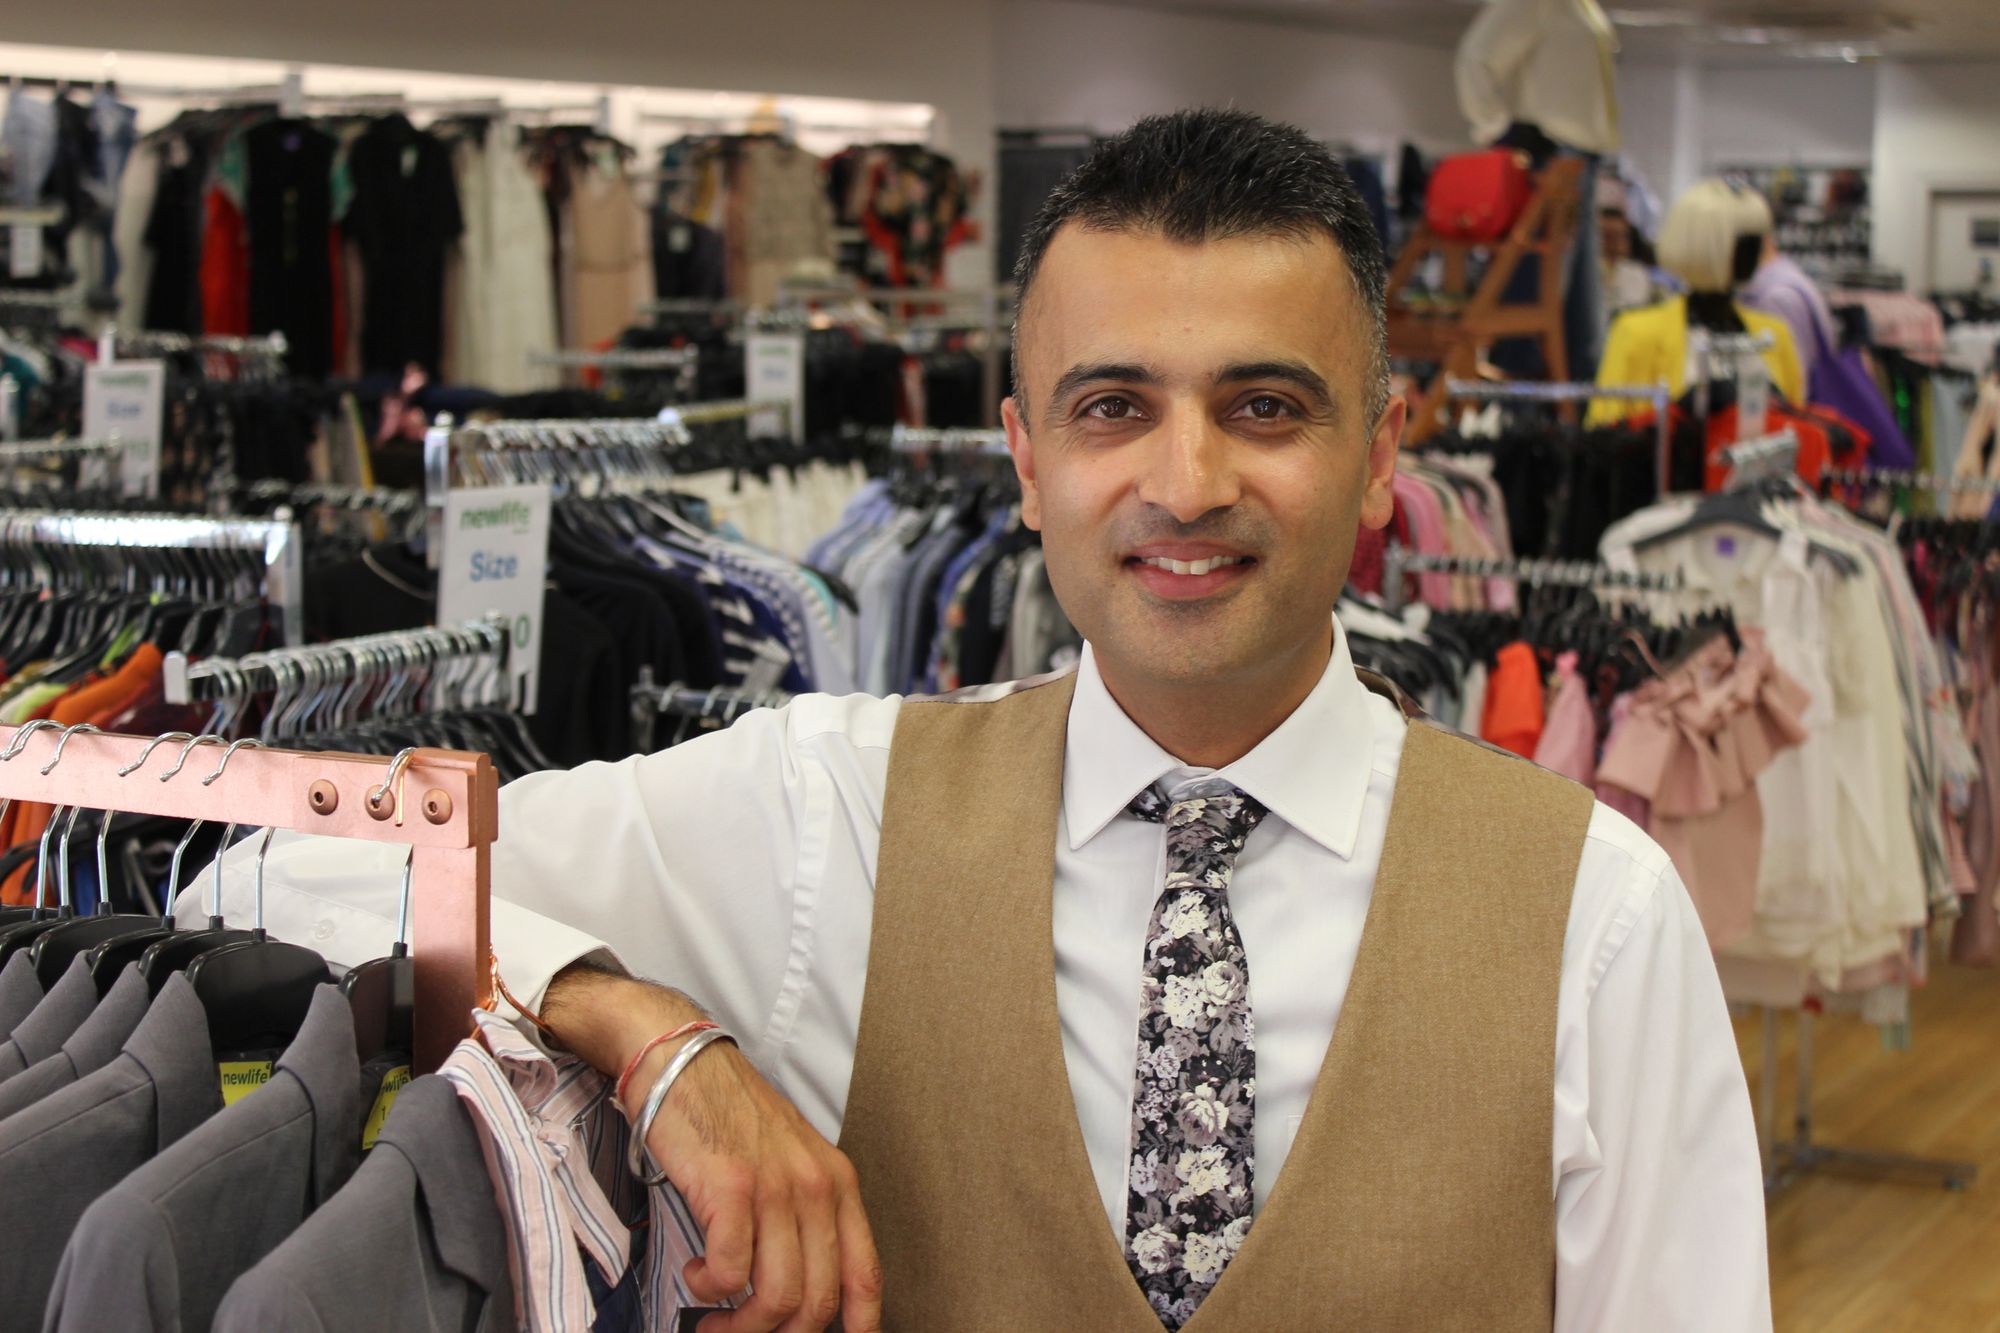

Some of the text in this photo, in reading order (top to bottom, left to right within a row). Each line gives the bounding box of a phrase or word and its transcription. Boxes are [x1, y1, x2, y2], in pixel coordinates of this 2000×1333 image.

[460, 501, 531, 529] newlife
[469, 551, 518, 582] Size
[506, 613, 530, 649] 0
[223, 1069, 268, 1085] newlife
